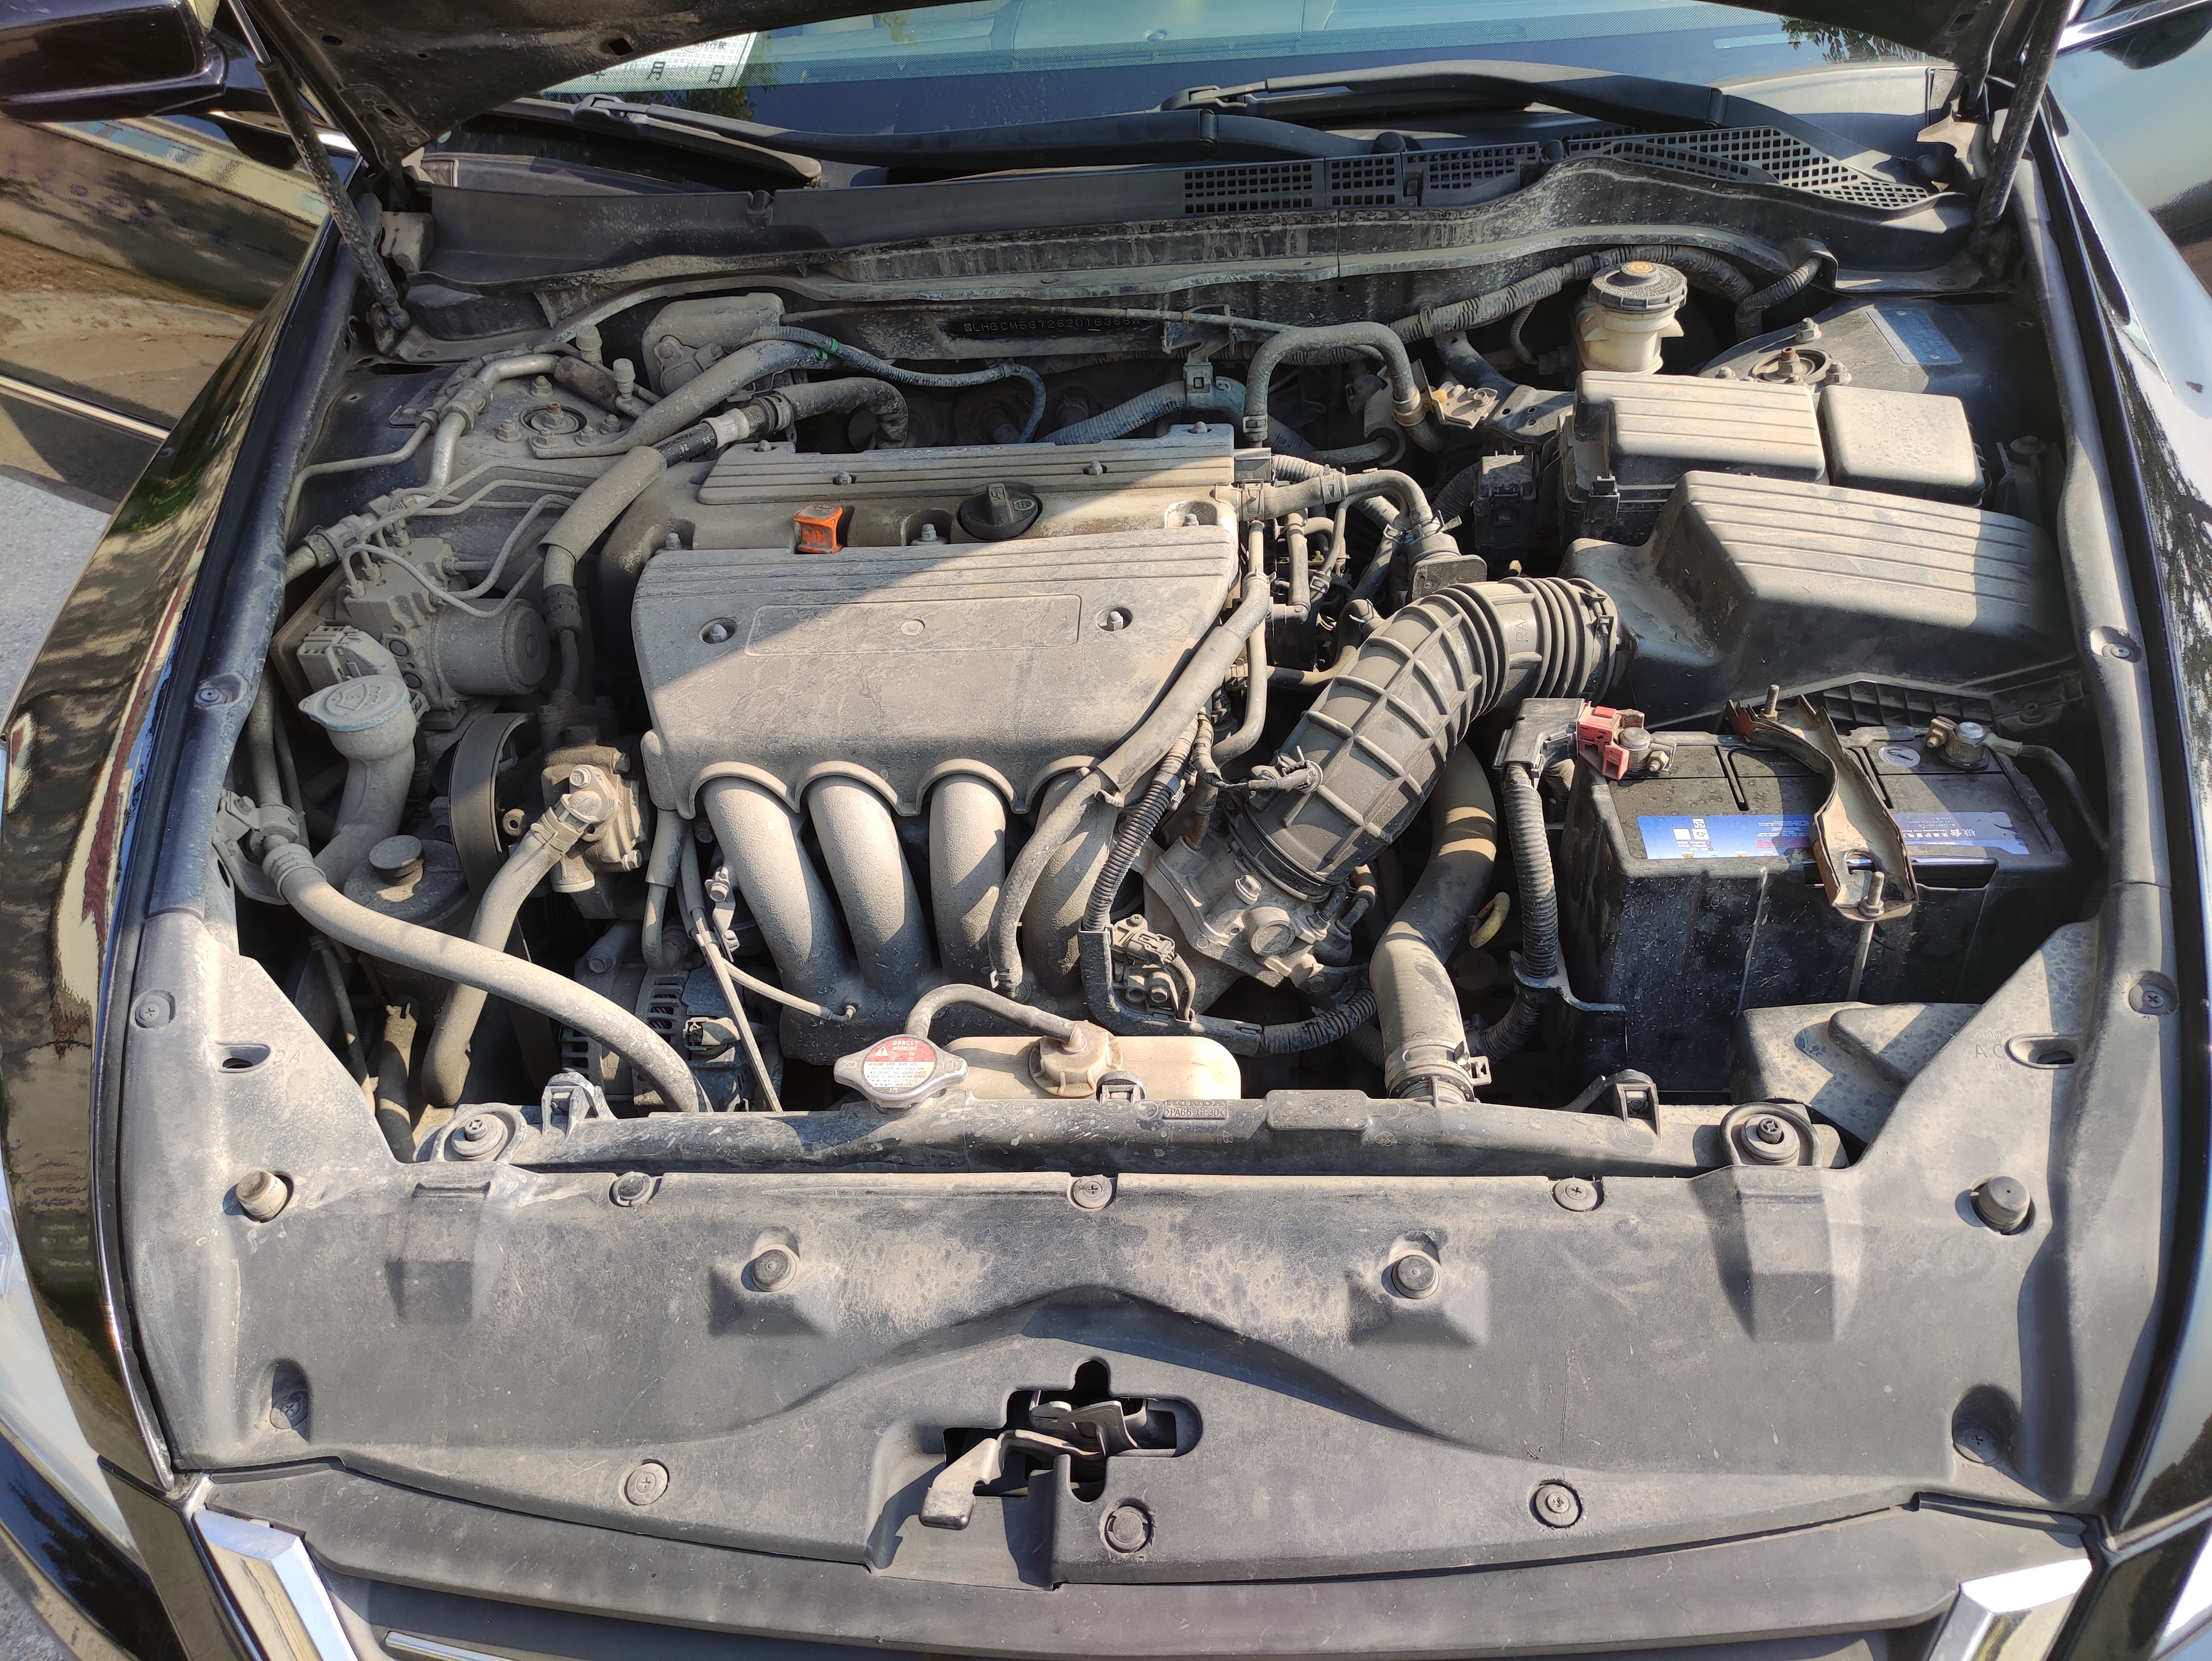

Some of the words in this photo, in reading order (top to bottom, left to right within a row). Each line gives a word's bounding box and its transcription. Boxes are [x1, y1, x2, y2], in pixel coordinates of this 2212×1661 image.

[1514, 612, 1528, 642] RAA
[1981, 1031, 2007, 1039] DOWN
[290, 1049, 303, 1063] A
[1975, 1043, 1988, 1058] A
[265, 1067, 288, 1075] DOWN
[1165, 1108, 1225, 1117] >PA66-GF30<
